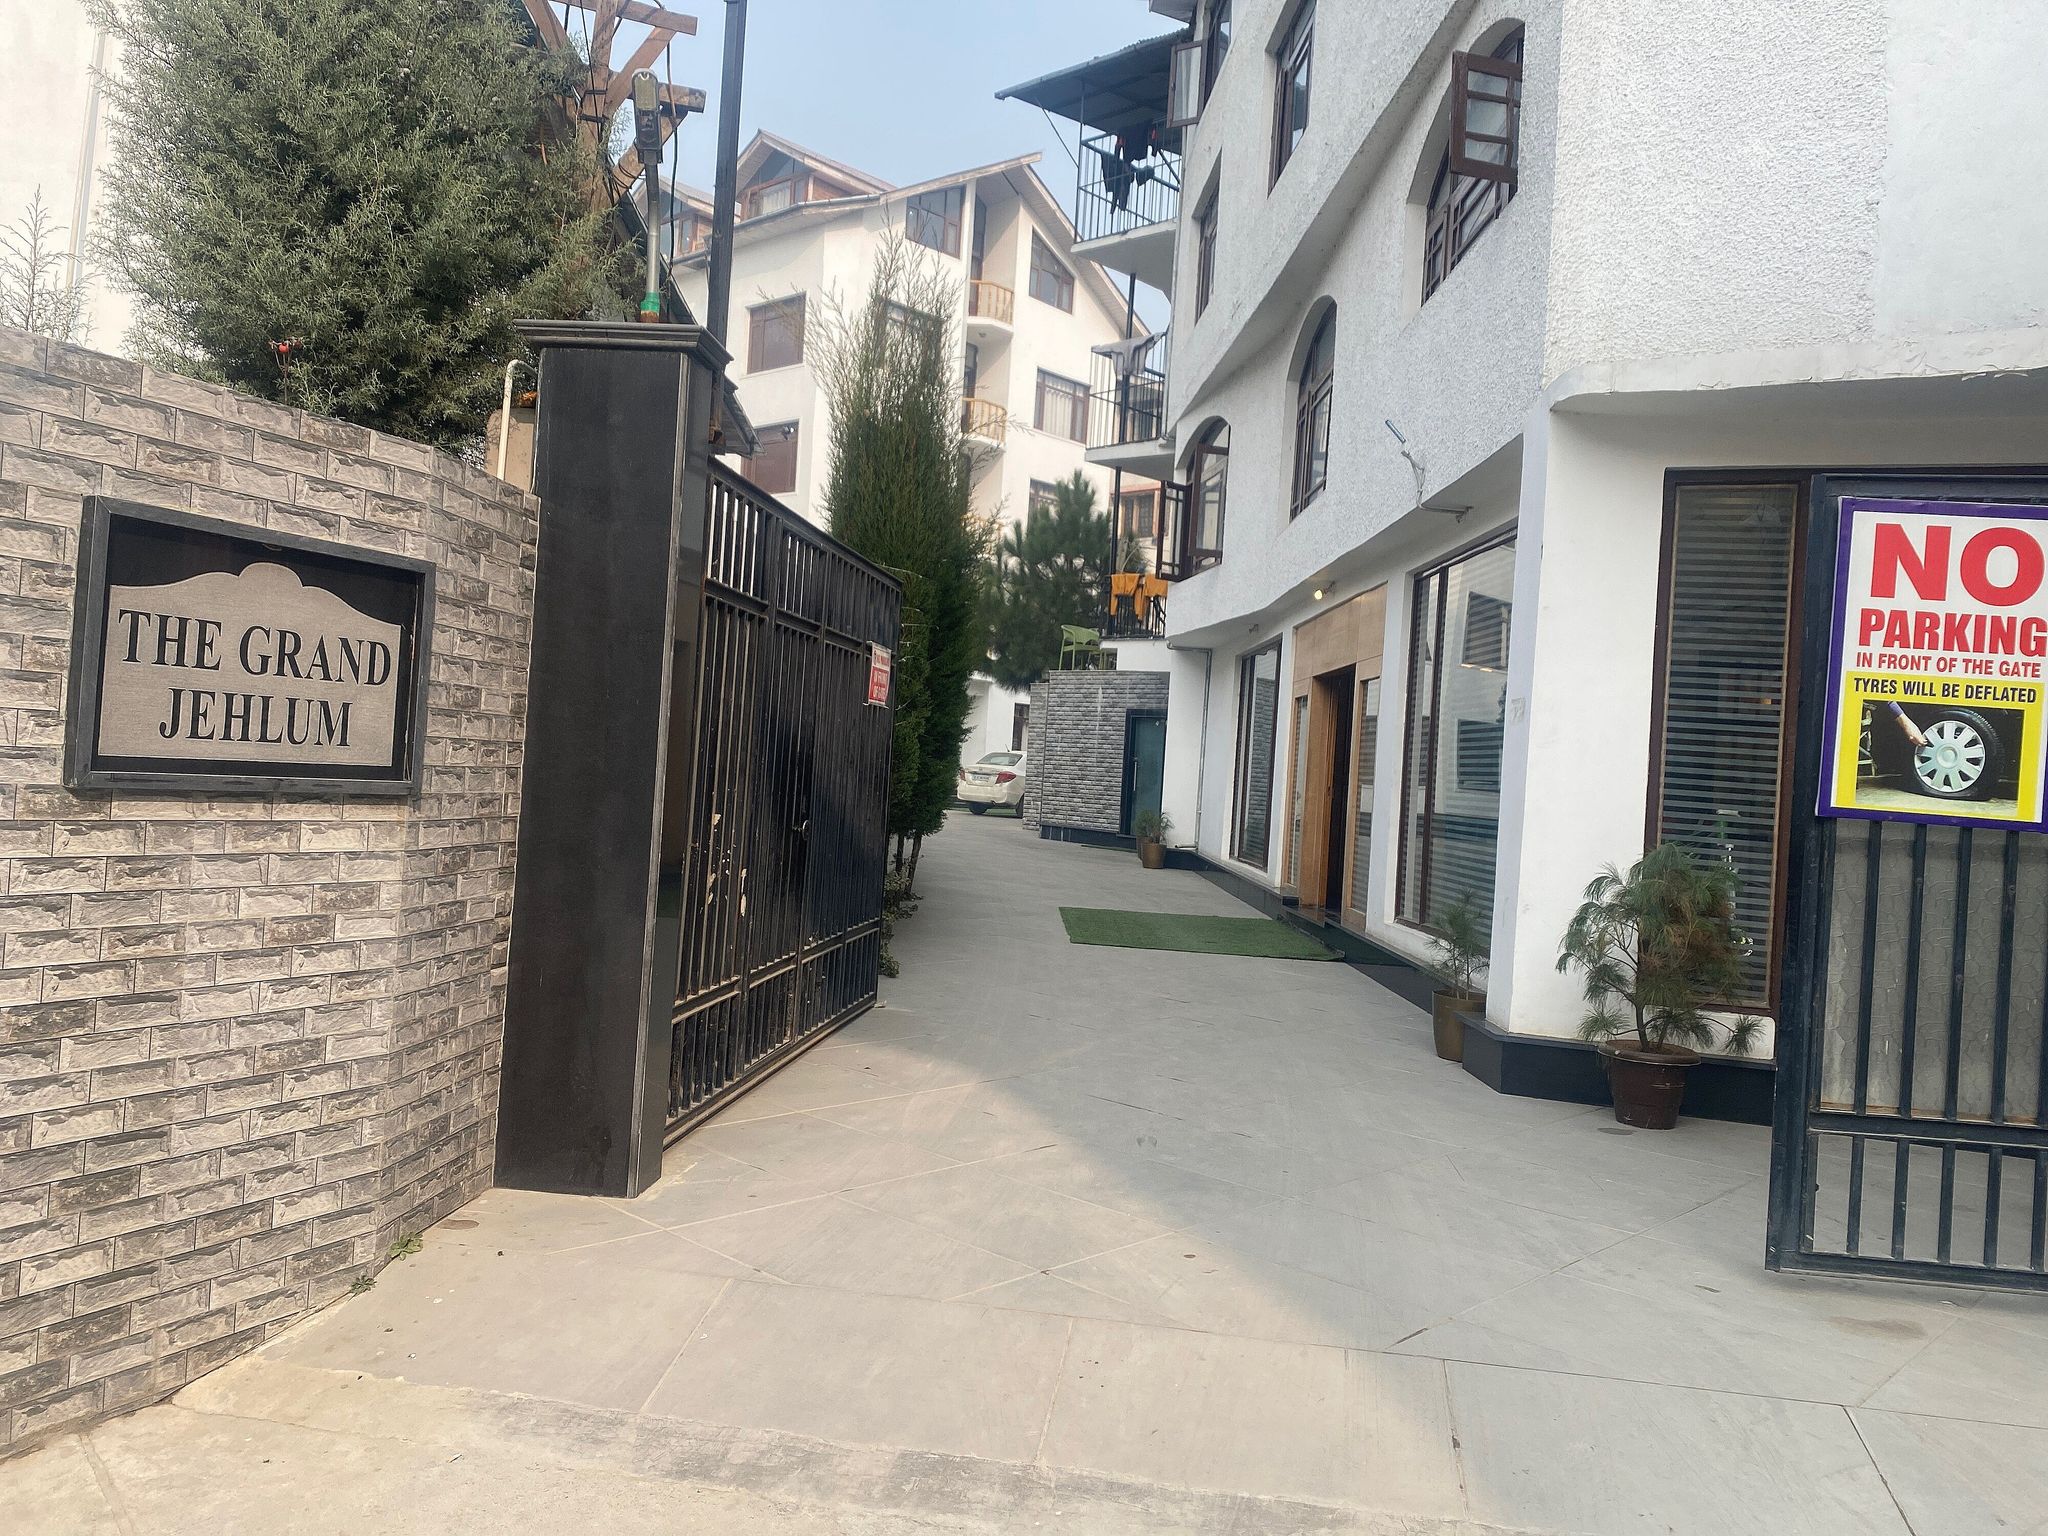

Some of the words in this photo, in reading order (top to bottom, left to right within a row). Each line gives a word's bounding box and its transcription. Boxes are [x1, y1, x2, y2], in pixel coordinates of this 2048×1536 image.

[1871, 523, 2045, 607] NO
[119, 609, 222, 671] THE
[239, 625, 391, 685] GRAND
[1858, 608, 2047, 657] PARKING
[1854, 678, 1898, 694] TYRES
[1903, 681, 1936, 697] WILL
[1942, 683, 1959, 699] BE
[1965, 685, 2036, 703] DEFLATED
[1857, 653, 1872, 668] IN
[1878, 654, 1930, 672] FRONT
[1937, 656, 1958, 673] OF
[1963, 659, 1994, 676] THE
[1999, 660, 2041, 678] GATE
[159, 688, 353, 747] JEHLUM
